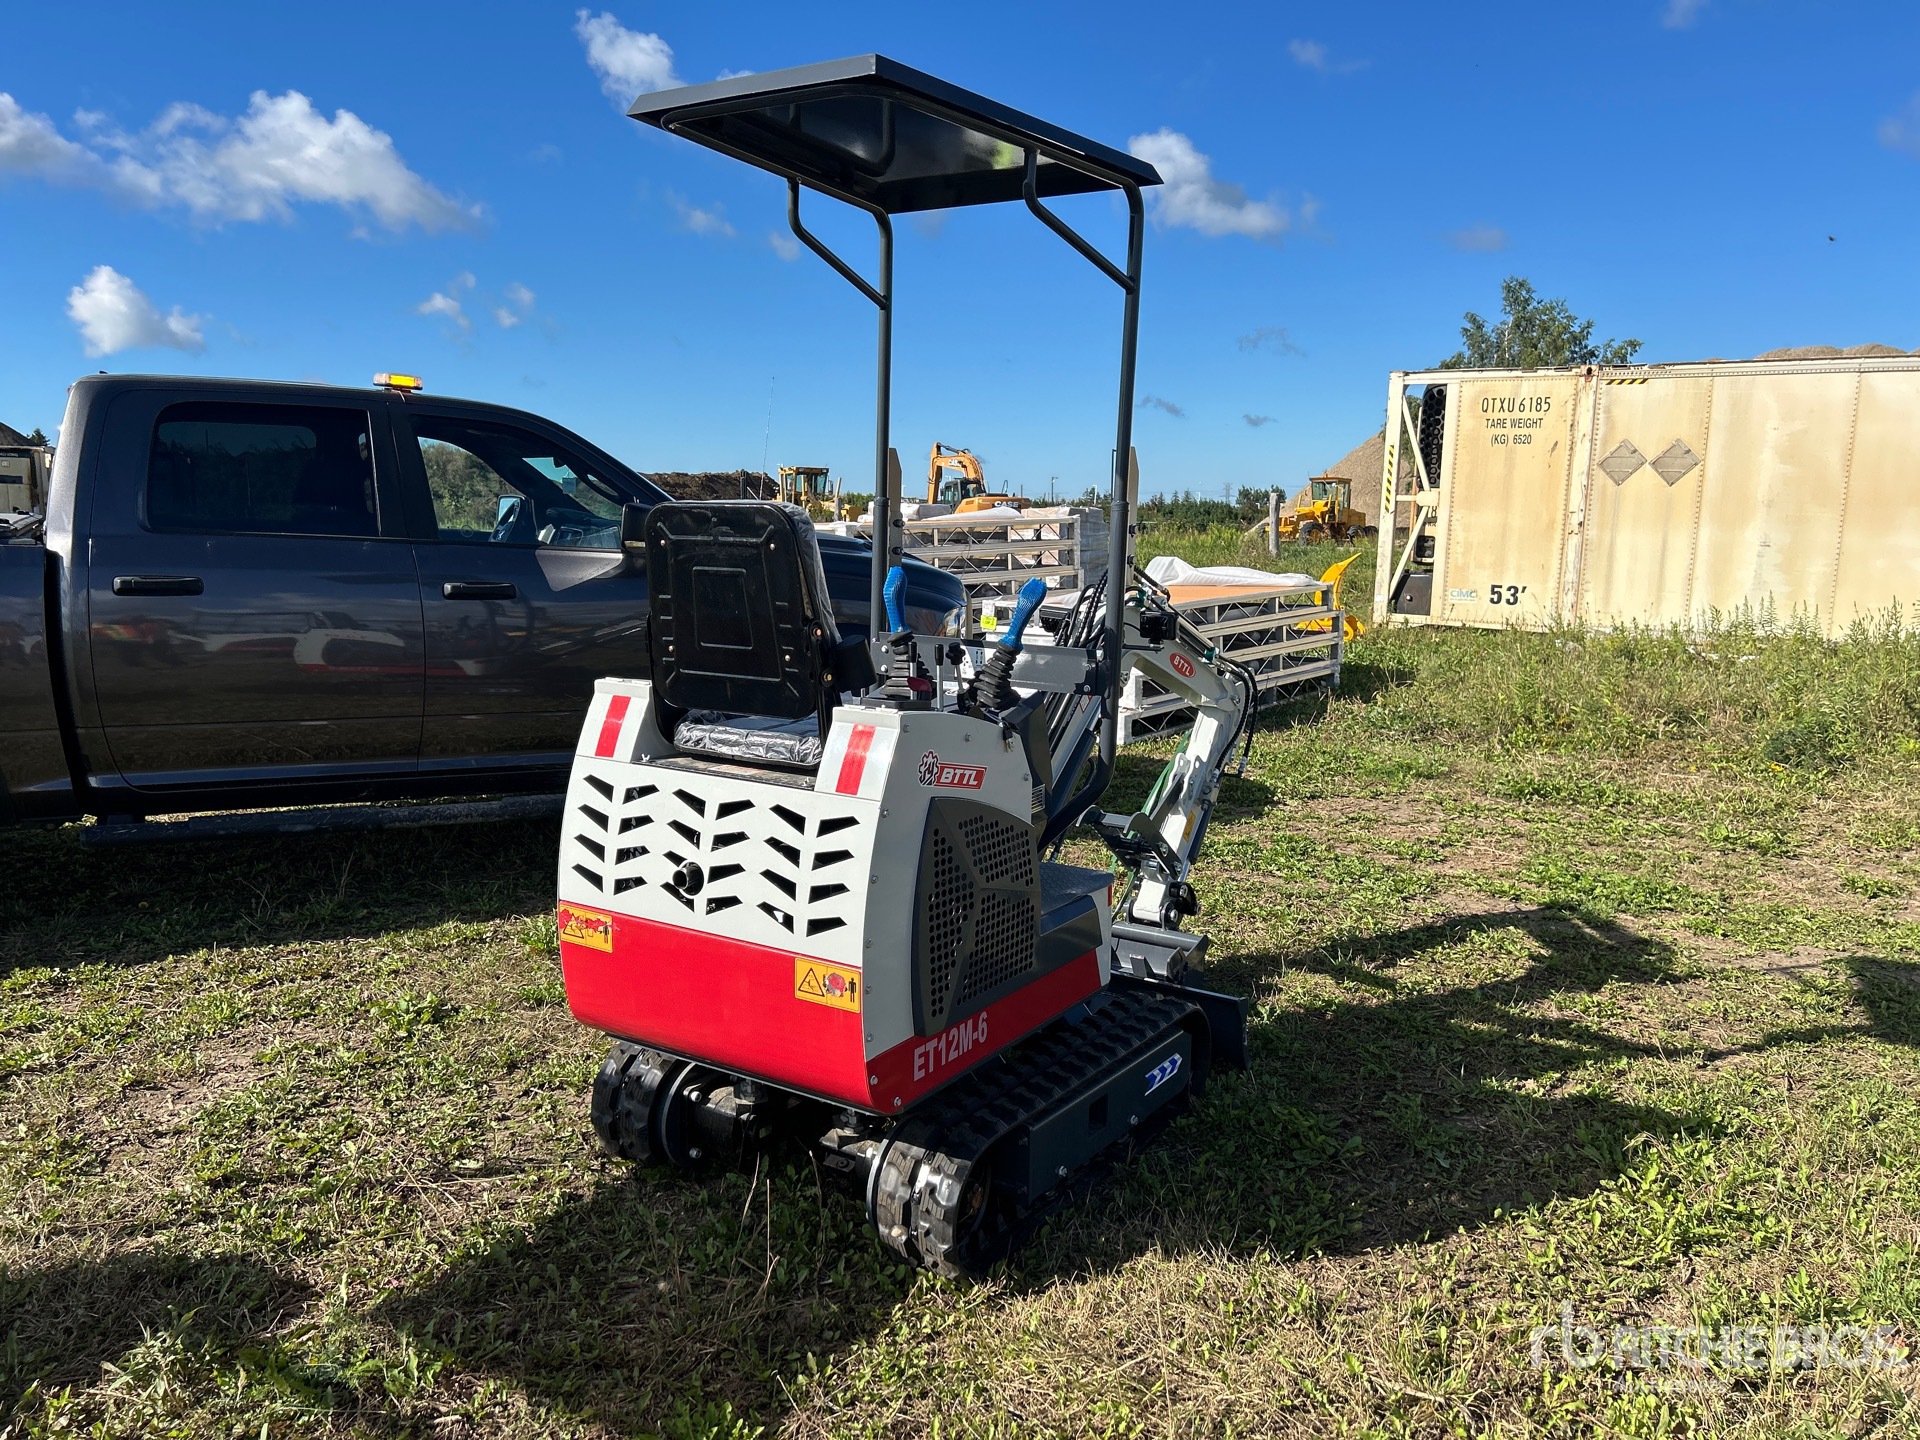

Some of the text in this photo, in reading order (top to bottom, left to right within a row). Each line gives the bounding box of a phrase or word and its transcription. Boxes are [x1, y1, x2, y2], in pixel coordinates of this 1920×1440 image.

[1481, 396, 1551, 413] QTXU 6185
[1485, 418, 1544, 429] TARE WEIGHT
[1491, 434, 1532, 447] (KG) 6520
[994, 500, 1019, 508] CASE
[1450, 590, 1476, 598] CIMC
[1489, 584, 1527, 605] 53'
[1173, 655, 1191, 676] BTTL
[940, 768, 978, 785] BTTL
[913, 1011, 988, 1082] ET12M-6
